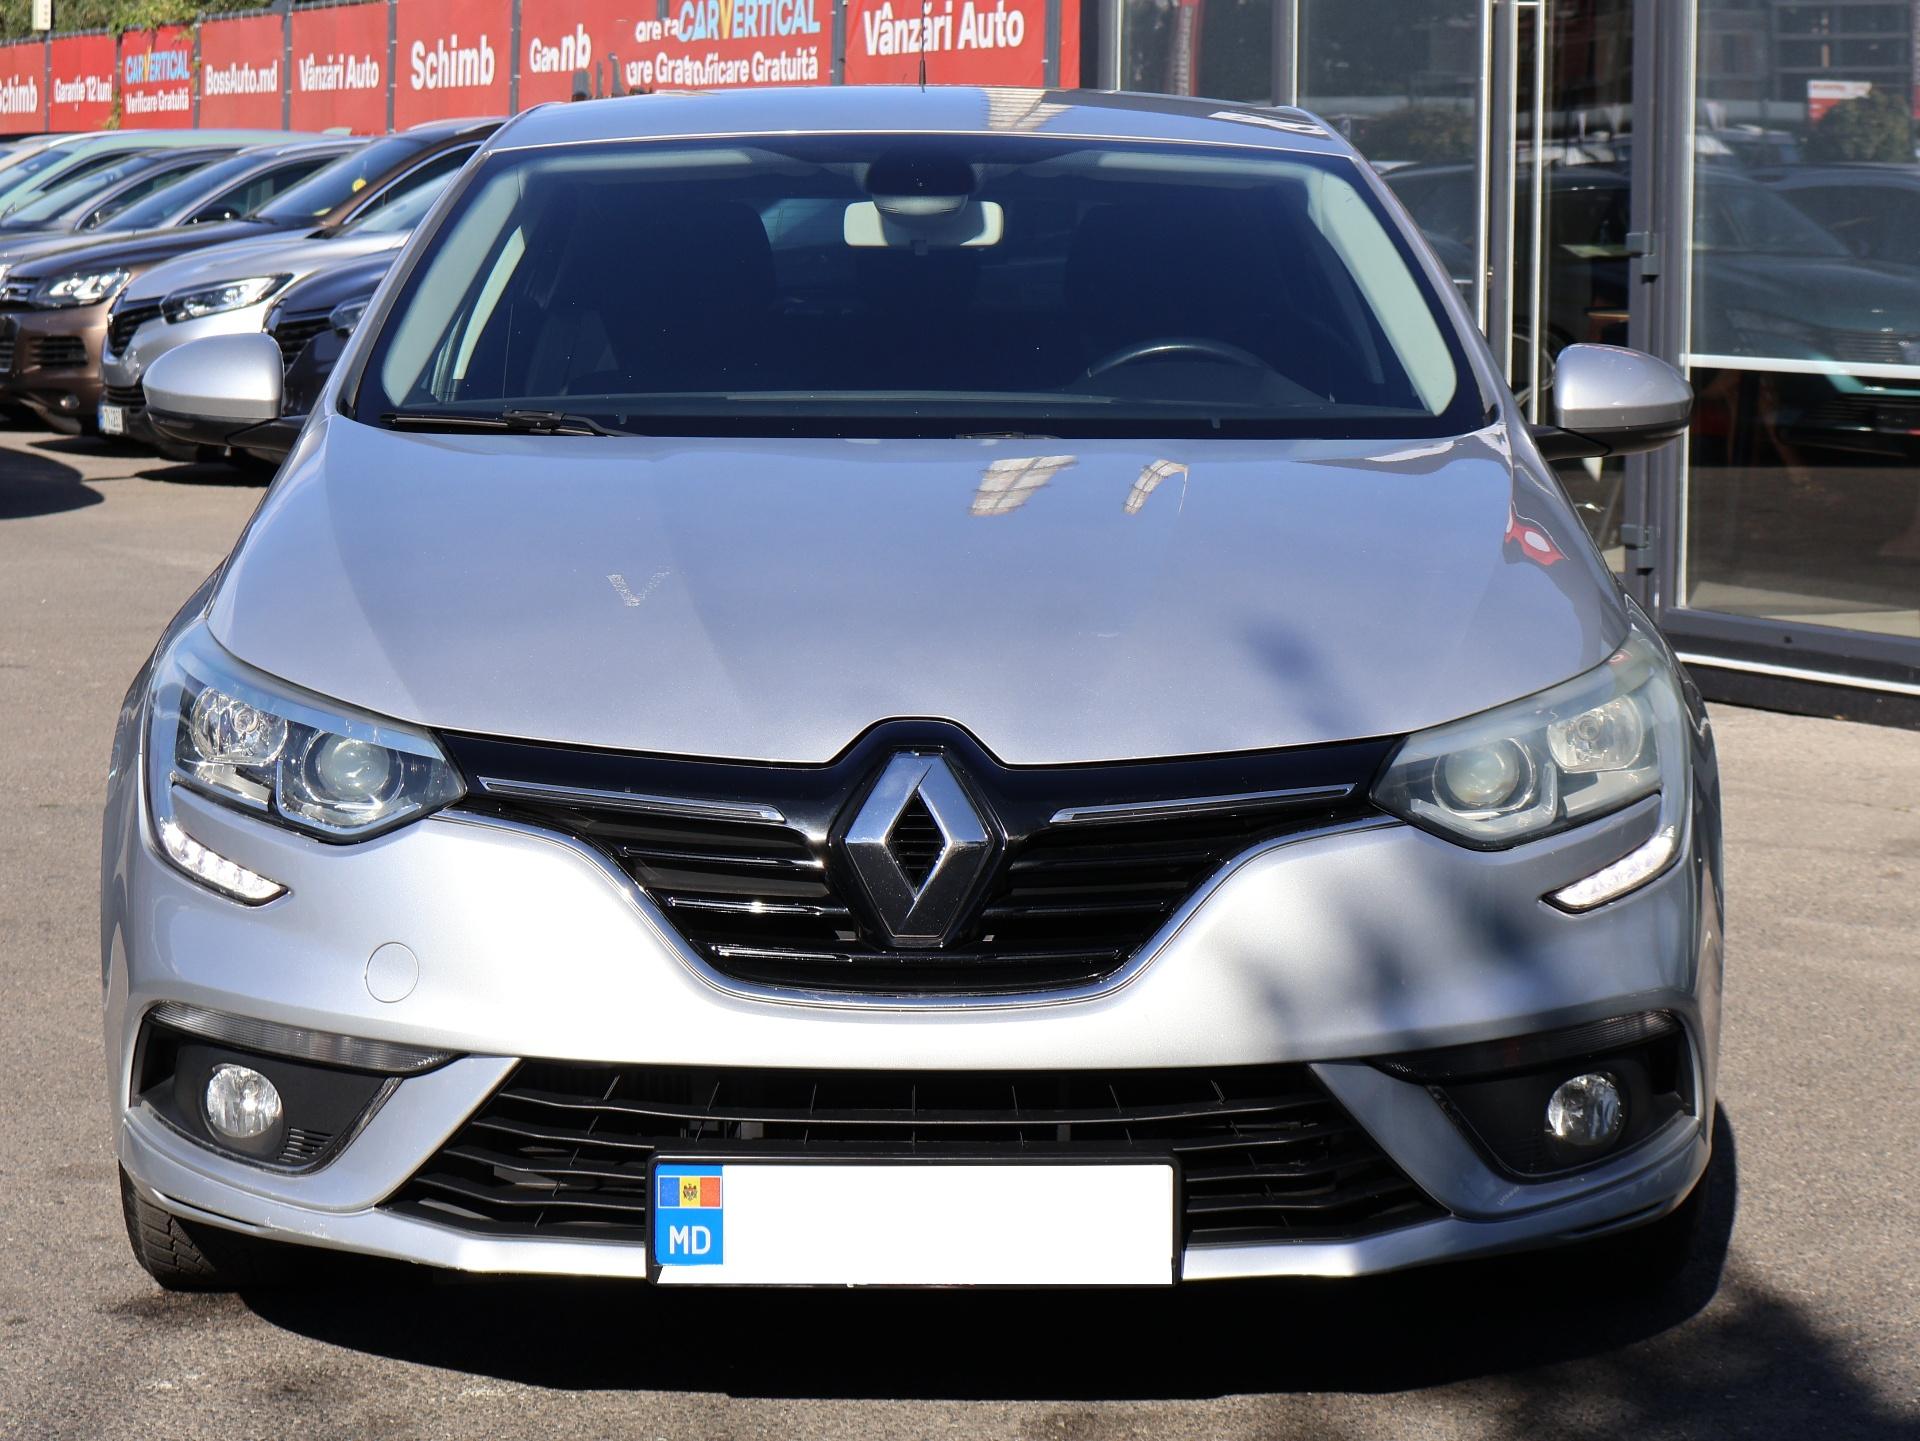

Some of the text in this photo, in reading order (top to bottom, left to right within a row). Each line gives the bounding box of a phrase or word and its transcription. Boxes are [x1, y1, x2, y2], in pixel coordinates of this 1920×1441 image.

[863, 0, 1025, 56] Vânzări Auto
[126, 45, 190, 84] CARVERTICAL
[205, 59, 278, 96] BossAuto.md
[345, 54, 379, 89] Auto
[411, 34, 495, 90] Schimb
[752, 46, 819, 82] Gratuită
[0, 73, 38, 114] chimb
[669, 1225, 711, 1255] MD
